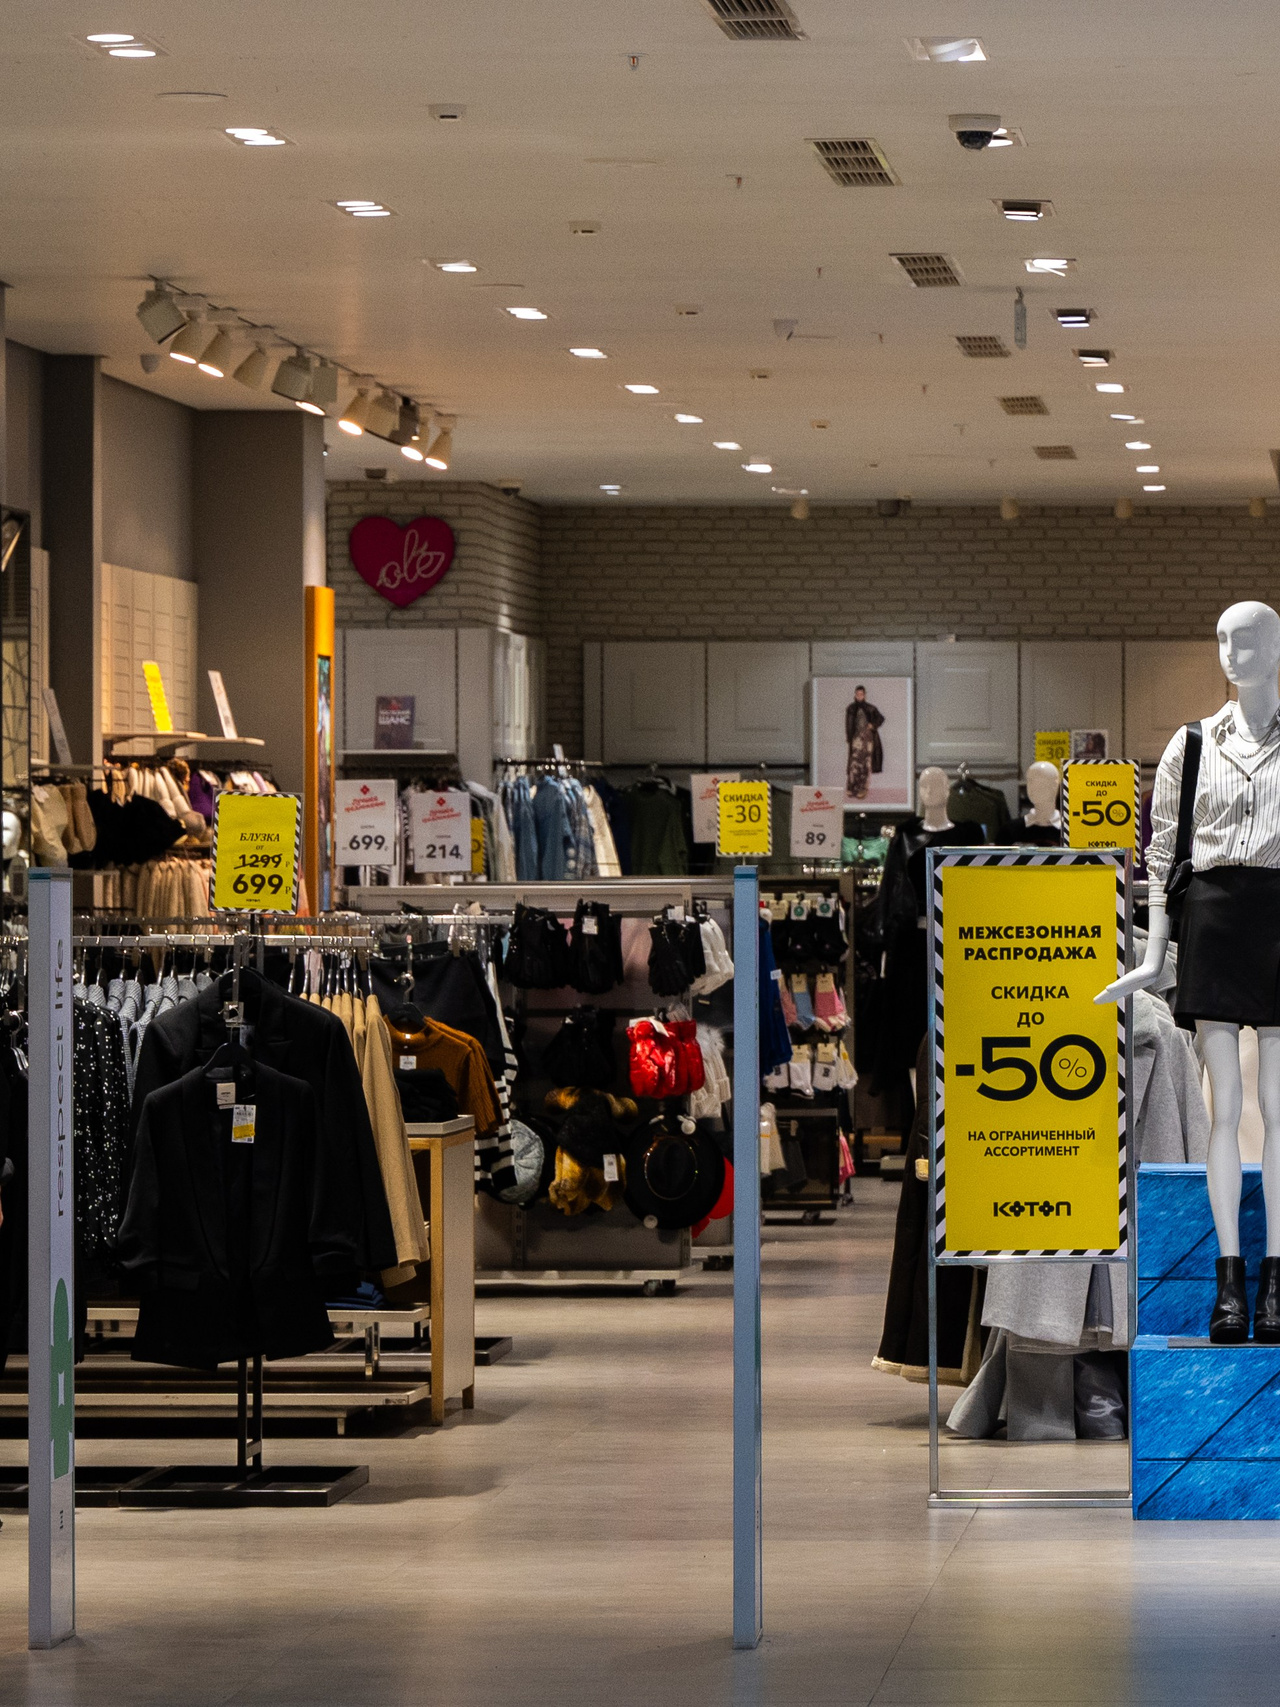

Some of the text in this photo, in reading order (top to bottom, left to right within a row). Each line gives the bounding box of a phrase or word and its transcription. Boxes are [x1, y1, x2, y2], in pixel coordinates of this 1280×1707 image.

[723, 793, 764, 803] СКИДКА
[240, 833, 280, 842] БЛУЗКА
[349, 835, 386, 851] 699
[805, 832, 826, 845] 89
[426, 844, 461, 859] 214
[234, 853, 283, 870] 1299
[232, 873, 283, 895] 699
[958, 925, 1102, 940] МЕЖСЕЗОННАЯ
[964, 946, 1097, 962] РАСПРОДАЖА
[991, 986, 1070, 1002] СКИДКА
[1017, 1012, 1045, 1028] ДО
[968, 1127, 1096, 1141] НА ОГРАНИЧЕННЫЙ
[984, 1146, 1080, 1157] АССОРТИМЕНТ
